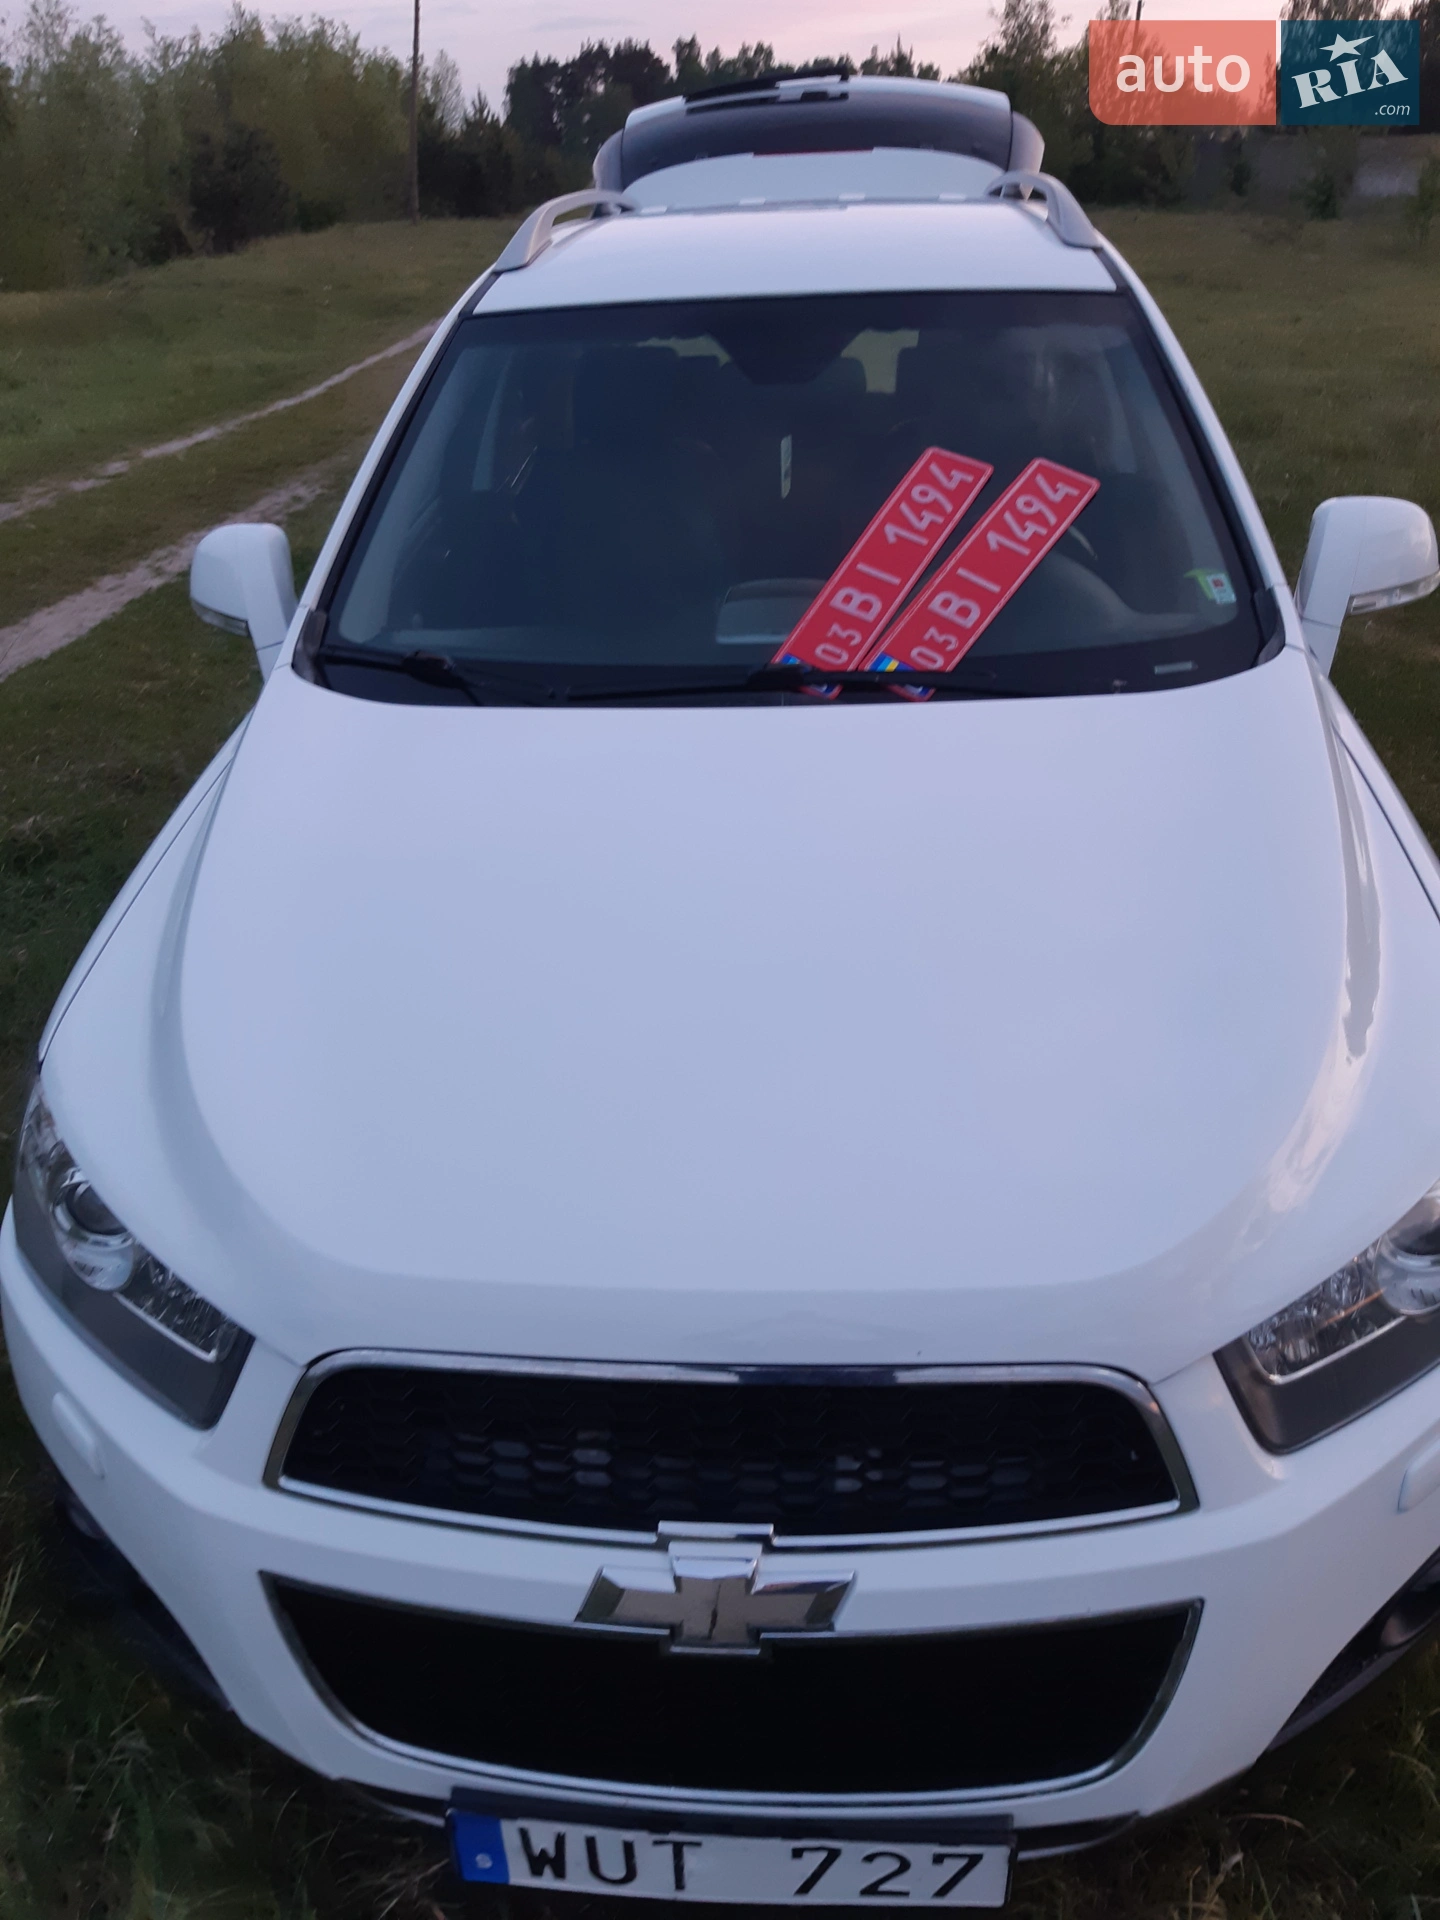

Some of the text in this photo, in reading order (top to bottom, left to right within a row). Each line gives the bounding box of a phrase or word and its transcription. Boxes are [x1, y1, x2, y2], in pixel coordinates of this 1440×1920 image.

[883, 462, 975, 546] 1494
[986, 473, 1080, 557] 1494
[518, 1827, 985, 1899] WUT 727
